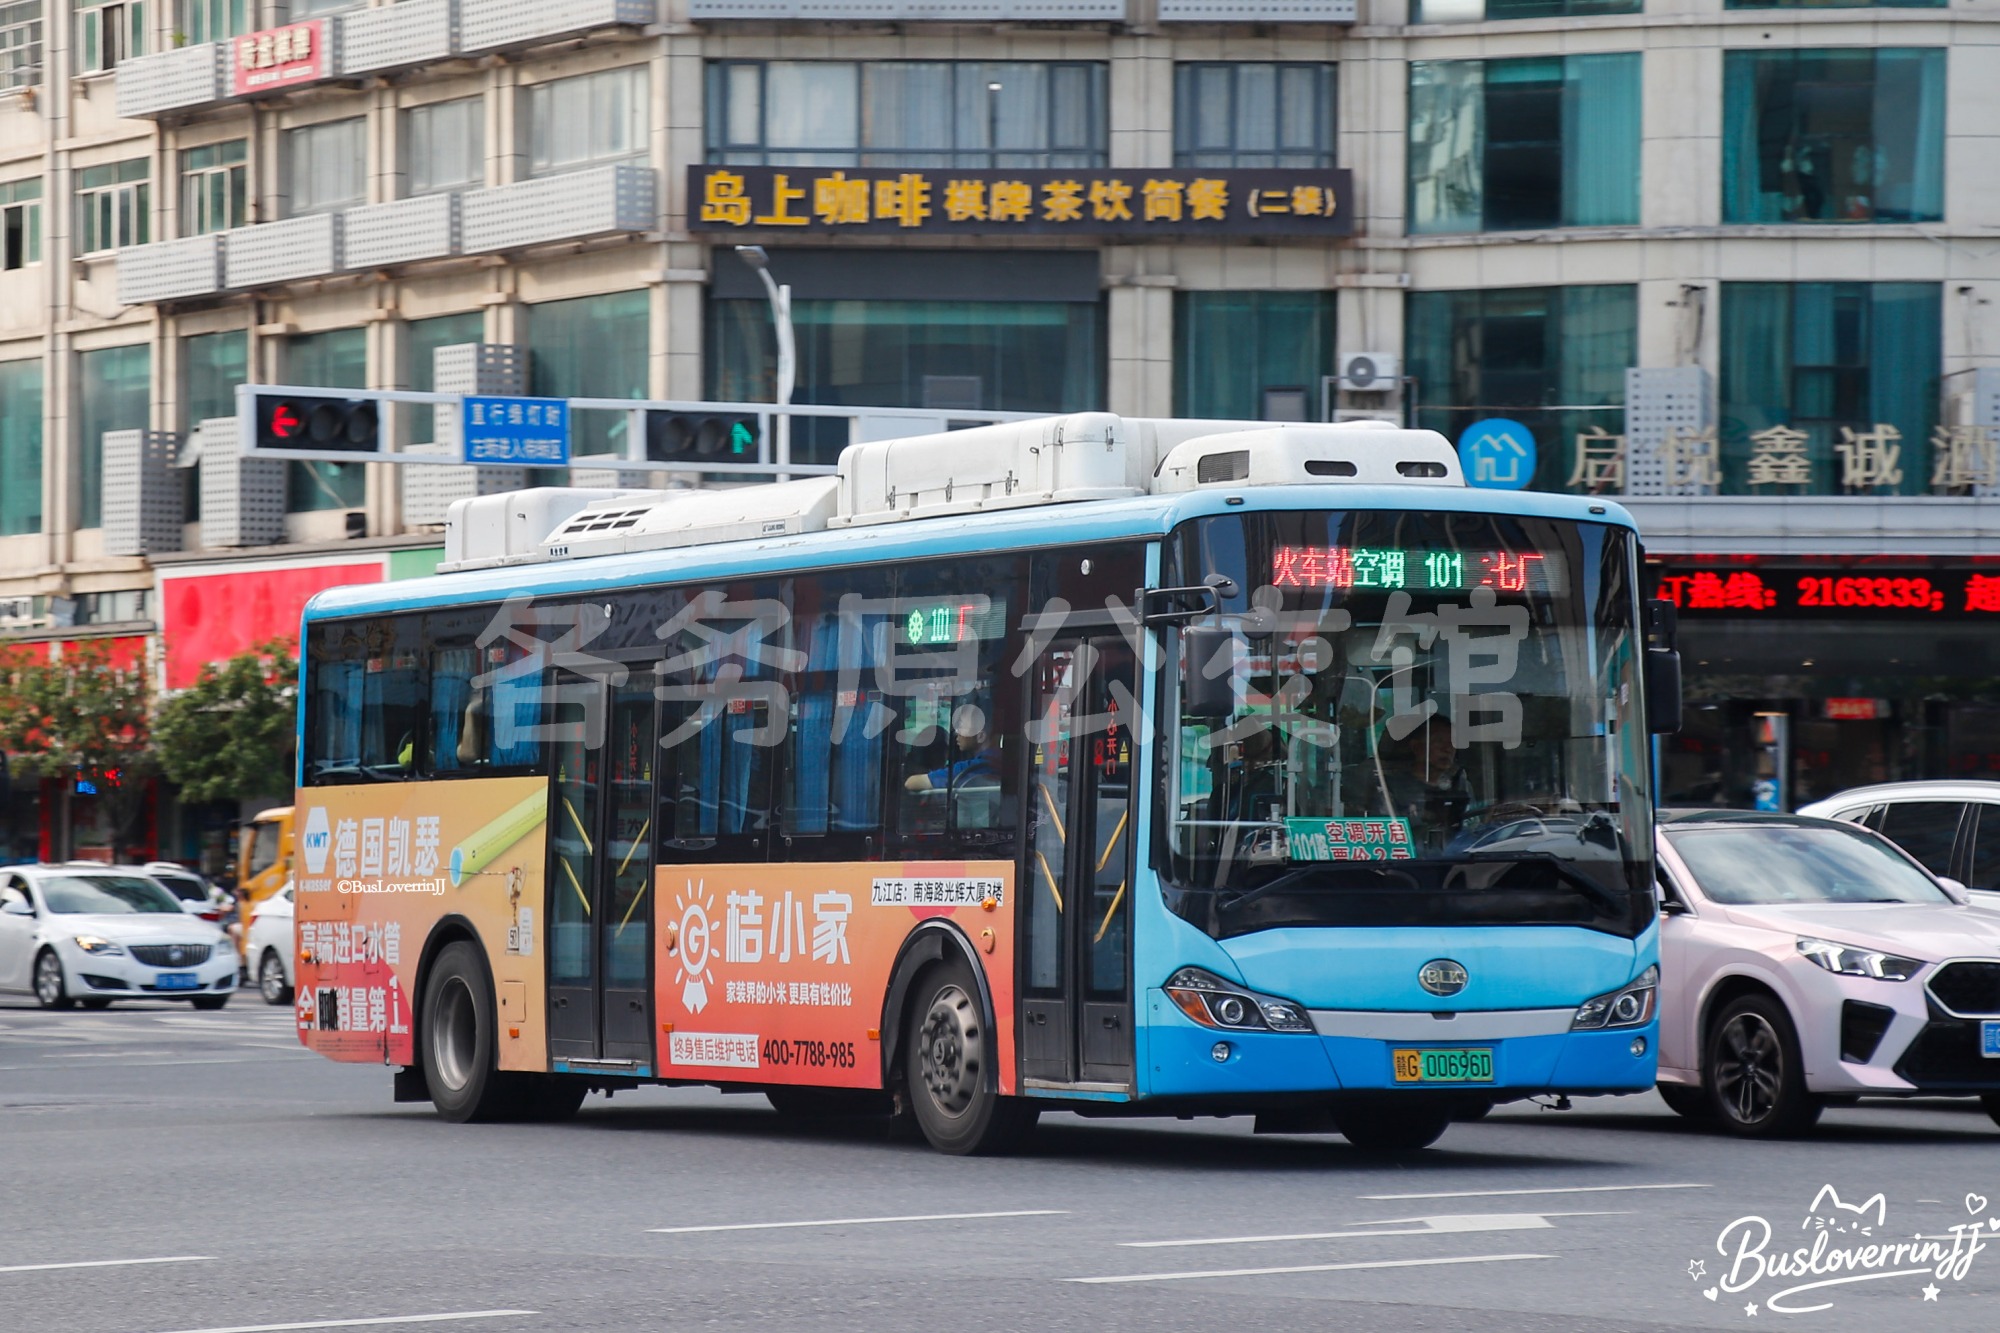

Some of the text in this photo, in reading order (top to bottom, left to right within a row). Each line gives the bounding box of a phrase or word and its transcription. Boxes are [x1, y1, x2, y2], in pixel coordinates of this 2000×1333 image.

[701, 170, 931, 227] 岛上咖啡
[1425, 553, 1462, 587] 101
[931, 607, 950, 641] 101
[306, 816, 440, 878] KWT 德国凯瑟
[1325, 822, 1408, 844] 空调开启
[913, 881, 1003, 902] 南海路光辉大厦3楼
[300, 921, 401, 965] 高端进口水管
[726, 889, 853, 964] 桔小家
[726, 981, 852, 1006] 家装界的小米 更具有性价比
[674, 1036, 856, 1069] 终身售后维护电话 400-7788-985
